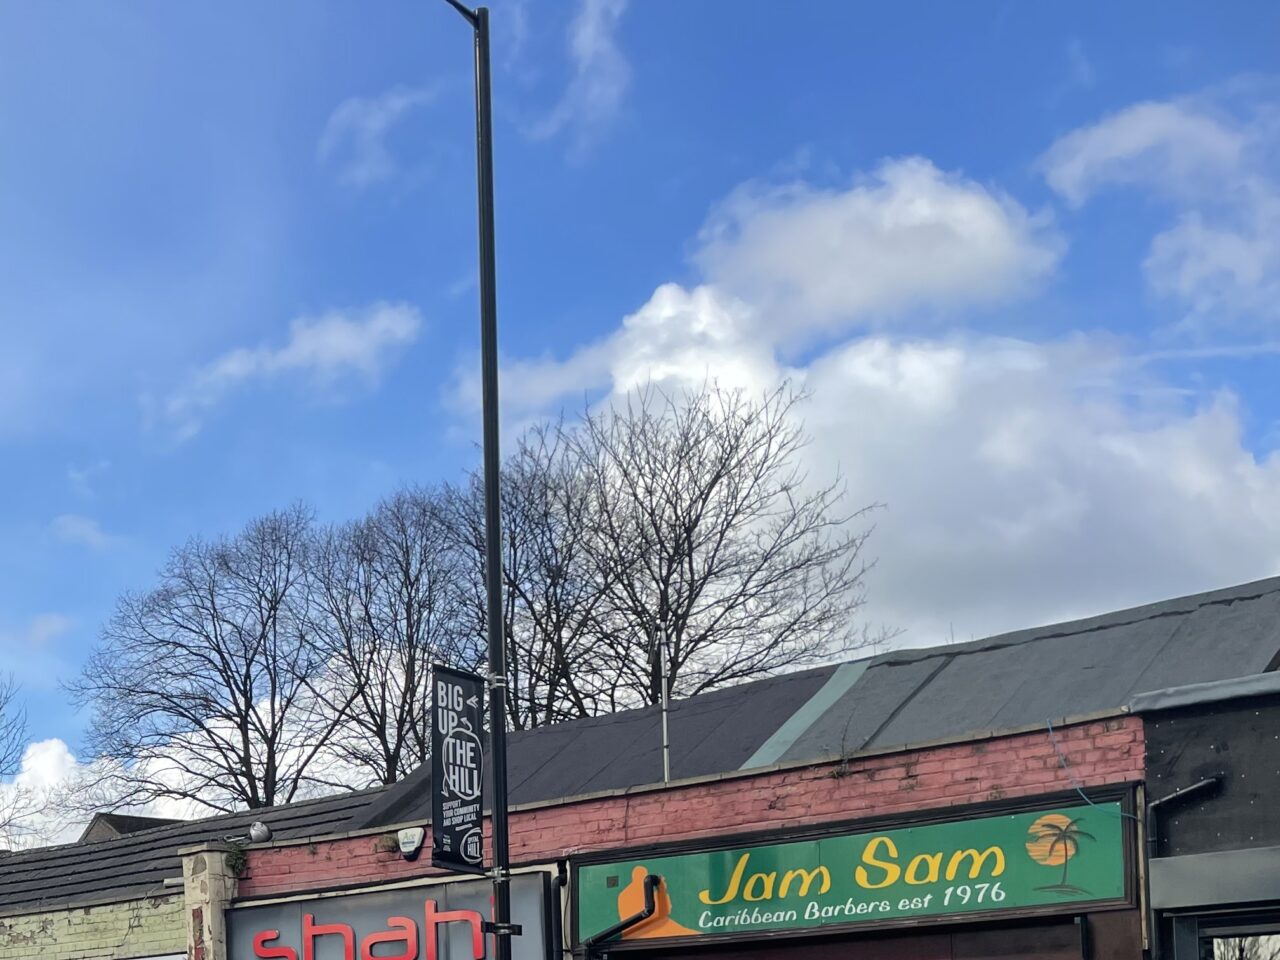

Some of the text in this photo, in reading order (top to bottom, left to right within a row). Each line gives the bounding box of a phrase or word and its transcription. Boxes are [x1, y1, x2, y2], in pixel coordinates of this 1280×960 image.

[437, 680, 464, 712] BIG
[437, 708, 458, 736] UP
[446, 737, 477, 768] THE
[449, 765, 481, 797] HILL
[464, 812, 477, 822] LOCAL
[467, 842, 480, 857] HILL
[698, 836, 1006, 905] Jam Sam
[698, 882, 1007, 928] Caribbean Barbers est 1976
